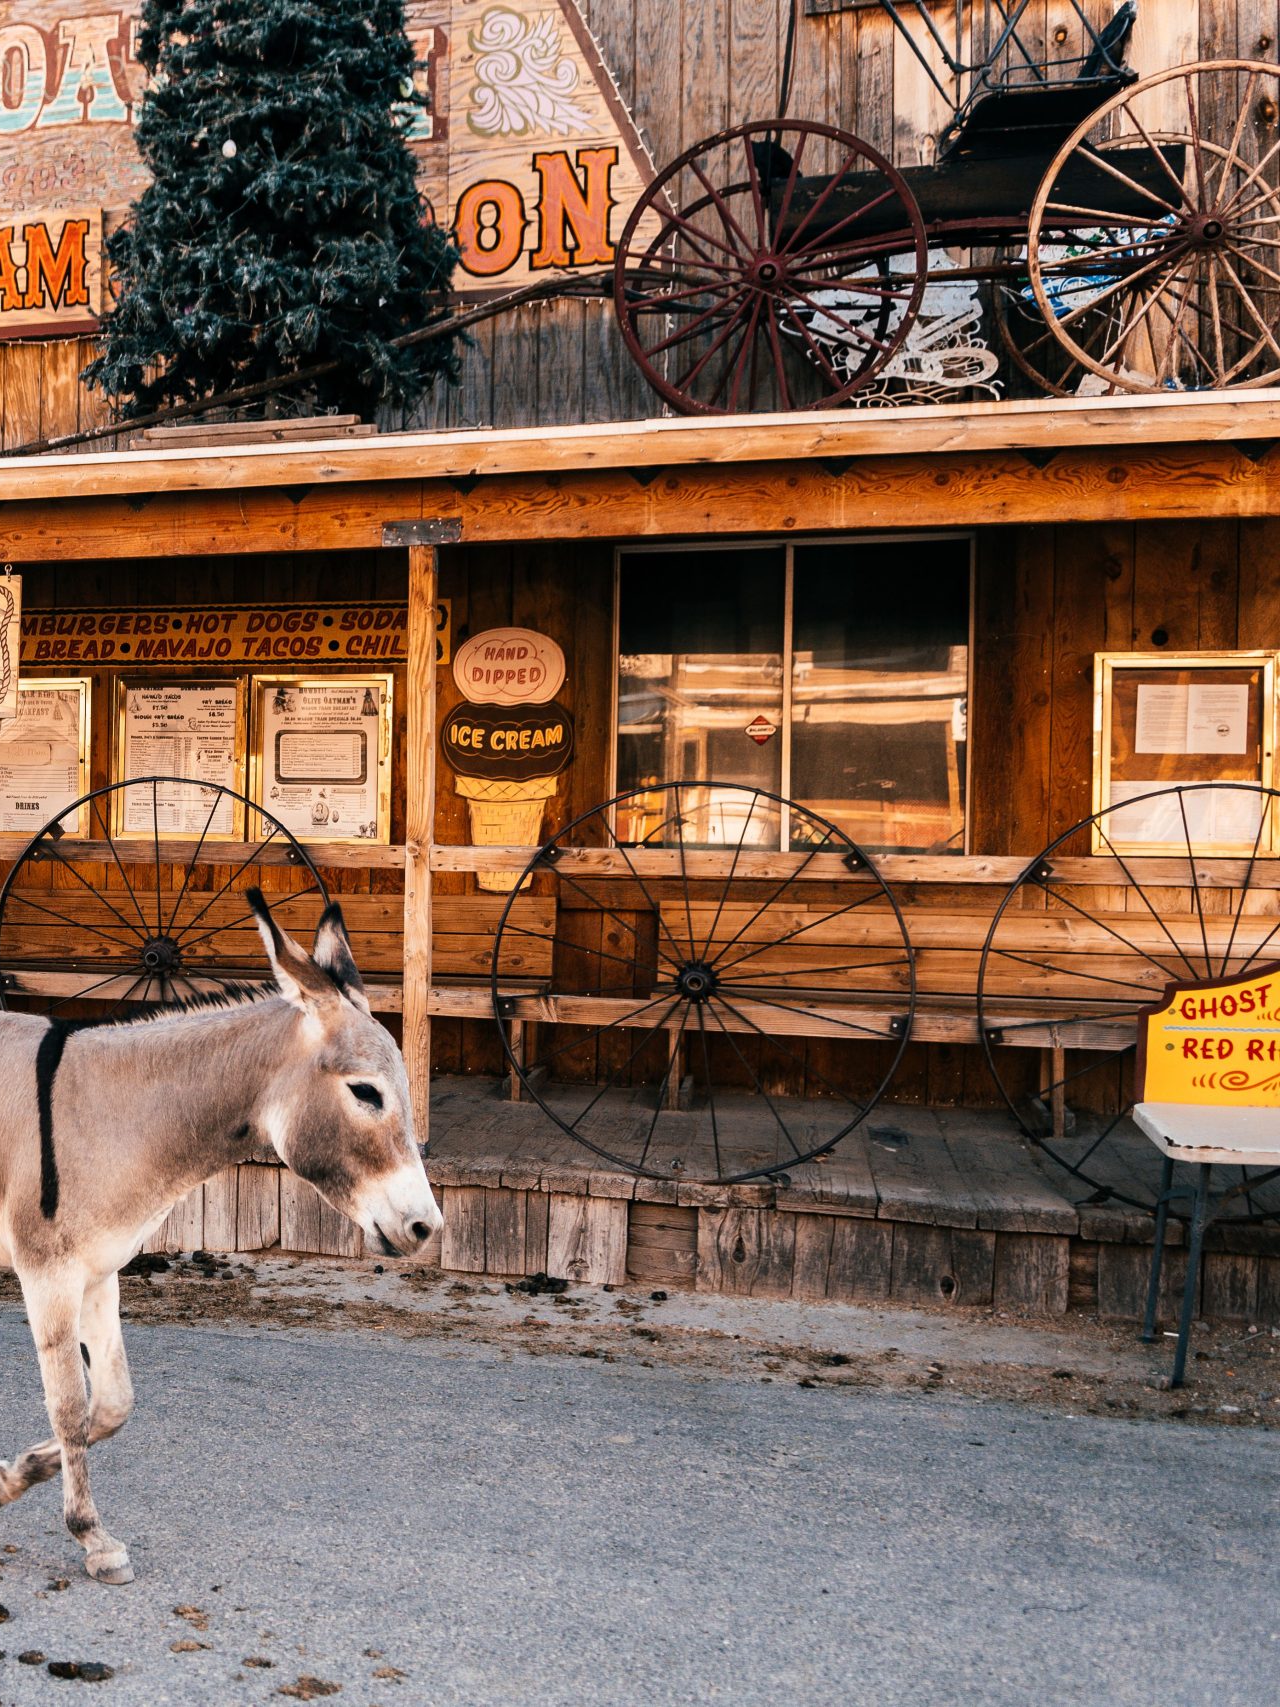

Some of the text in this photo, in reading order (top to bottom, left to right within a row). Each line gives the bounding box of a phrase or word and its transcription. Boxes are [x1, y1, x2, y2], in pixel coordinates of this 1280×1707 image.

[432, 146, 618, 277] ON
[21, 610, 408, 636] MBURGERS HOT DOGS SODA
[35, 639, 116, 659] BREAD
[135, 638, 232, 658] NAVAJO
[242, 636, 323, 657] TACOS
[346, 634, 408, 656] CHIL
[484, 646, 529, 662] HAND
[472, 666, 542, 685] DIPPED
[451, 725, 563, 750] ICE CREAM
[15, 802, 40, 811] DRINKS
[1180, 984, 1273, 1021] GHOST
[1182, 1038, 1234, 1060] RED
